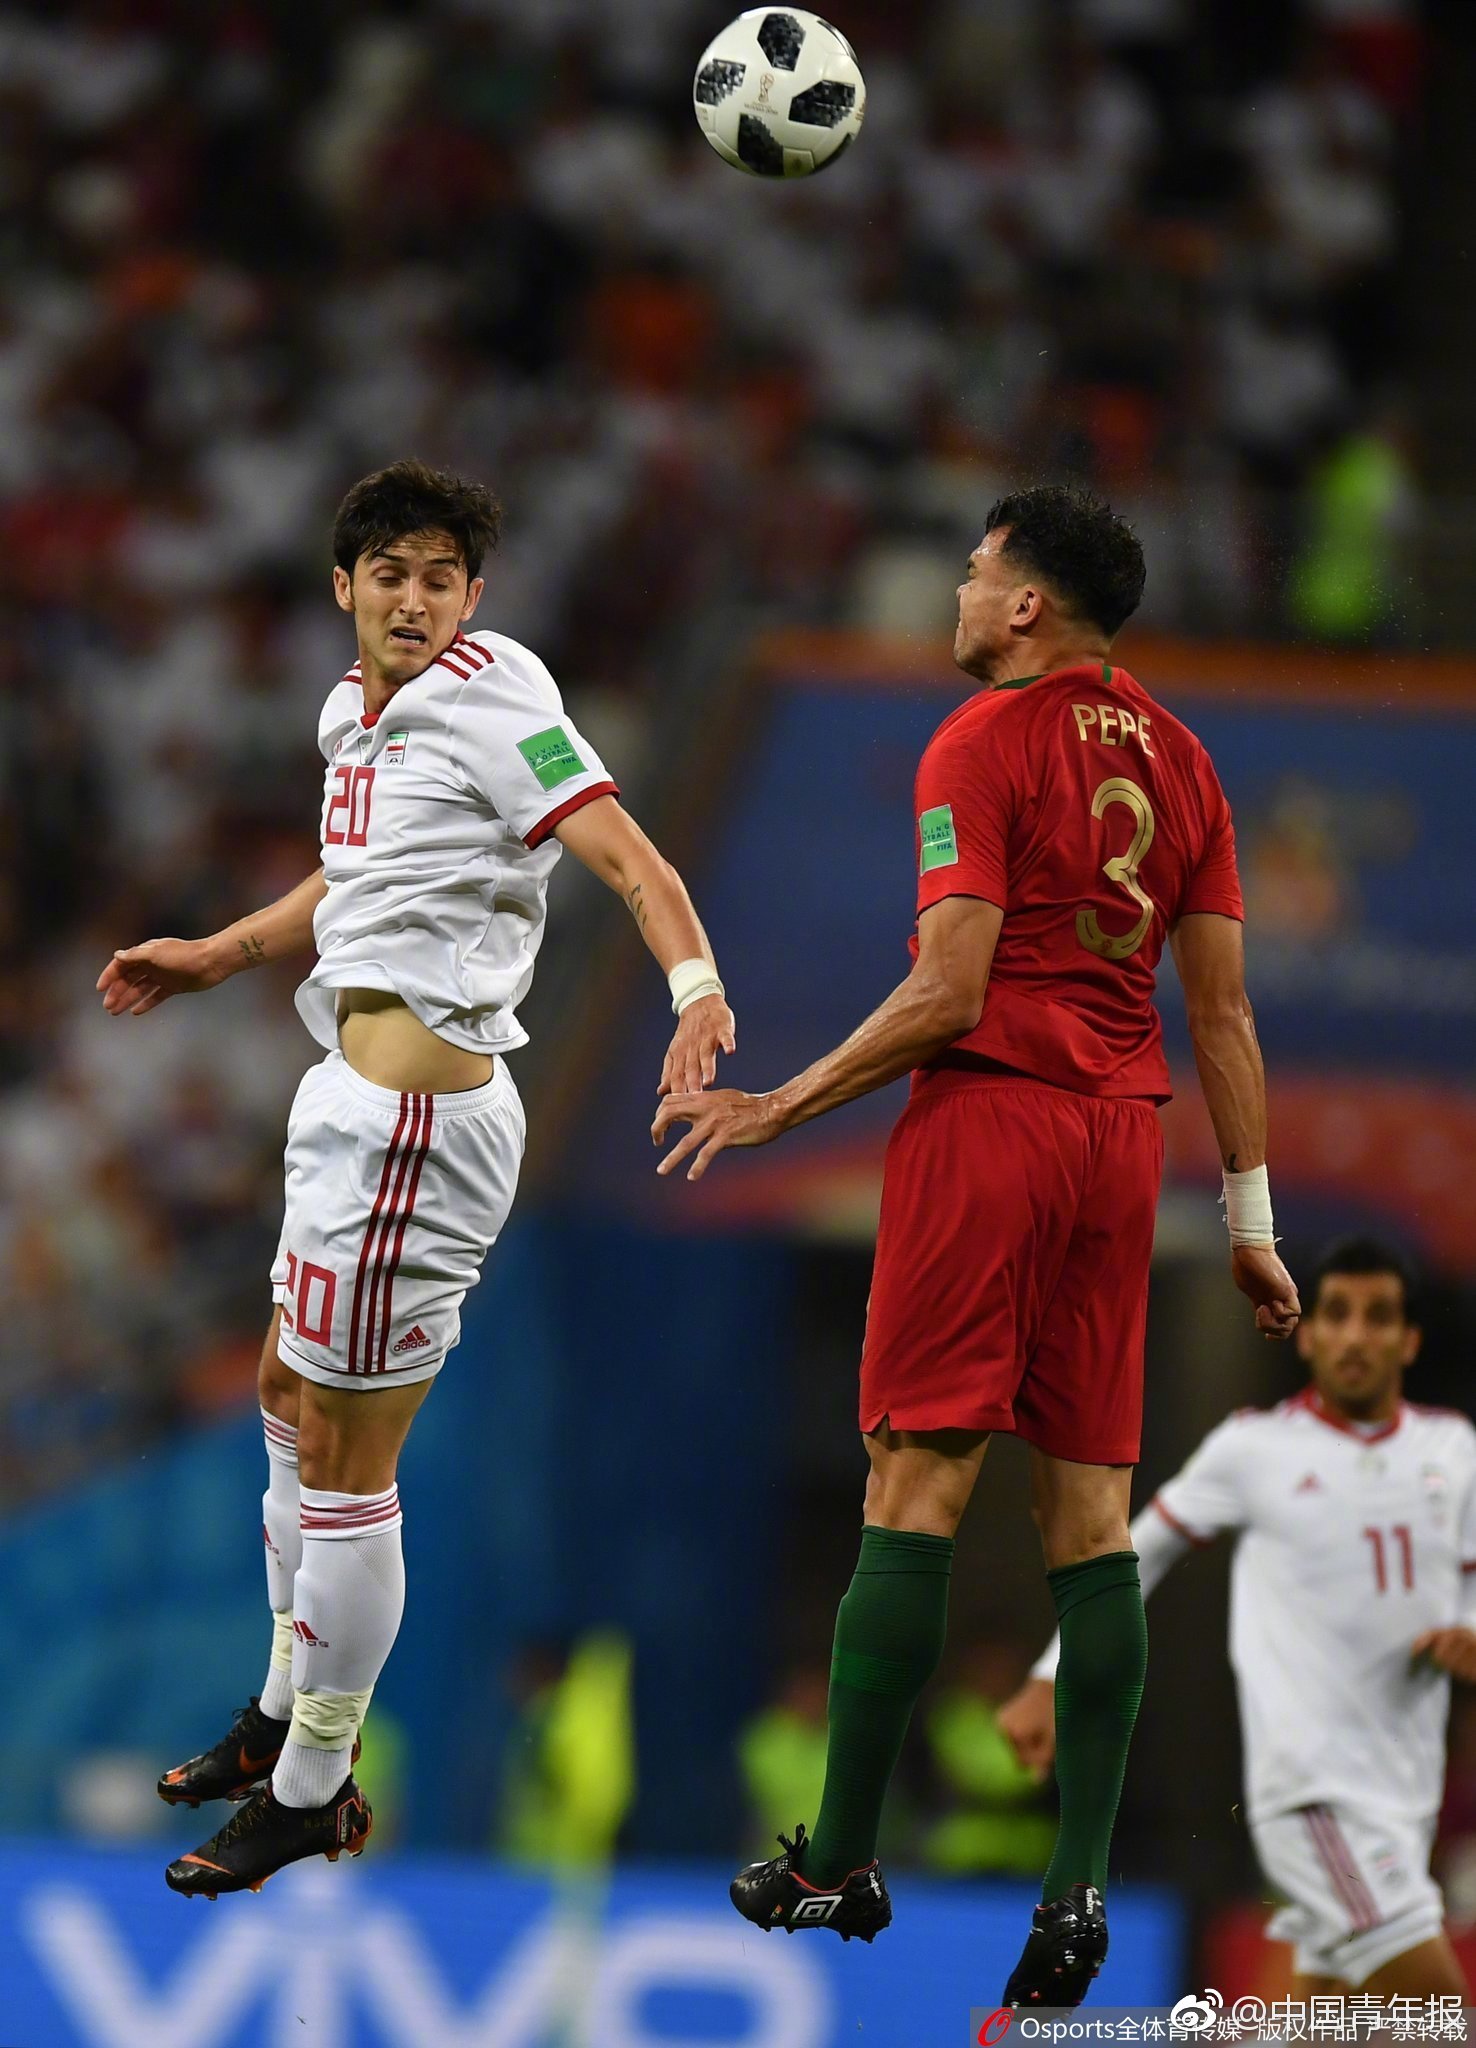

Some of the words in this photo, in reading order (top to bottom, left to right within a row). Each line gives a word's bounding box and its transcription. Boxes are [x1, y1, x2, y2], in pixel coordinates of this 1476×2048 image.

[1071, 703, 1155, 759] PEPE
[528, 741, 568, 761] LIVING
[561, 756, 577, 765] FIFA
[325, 766, 376, 847] 20
[923, 823, 950, 836] VING
[936, 842, 953, 852] FIFA
[1075, 777, 1155, 960] 3
[393, 1338, 432, 1352] adidas
[1363, 1524, 1414, 1596] 11
[869, 1871, 882, 1899] umbro
[1086, 1888, 1095, 1915] umbro
